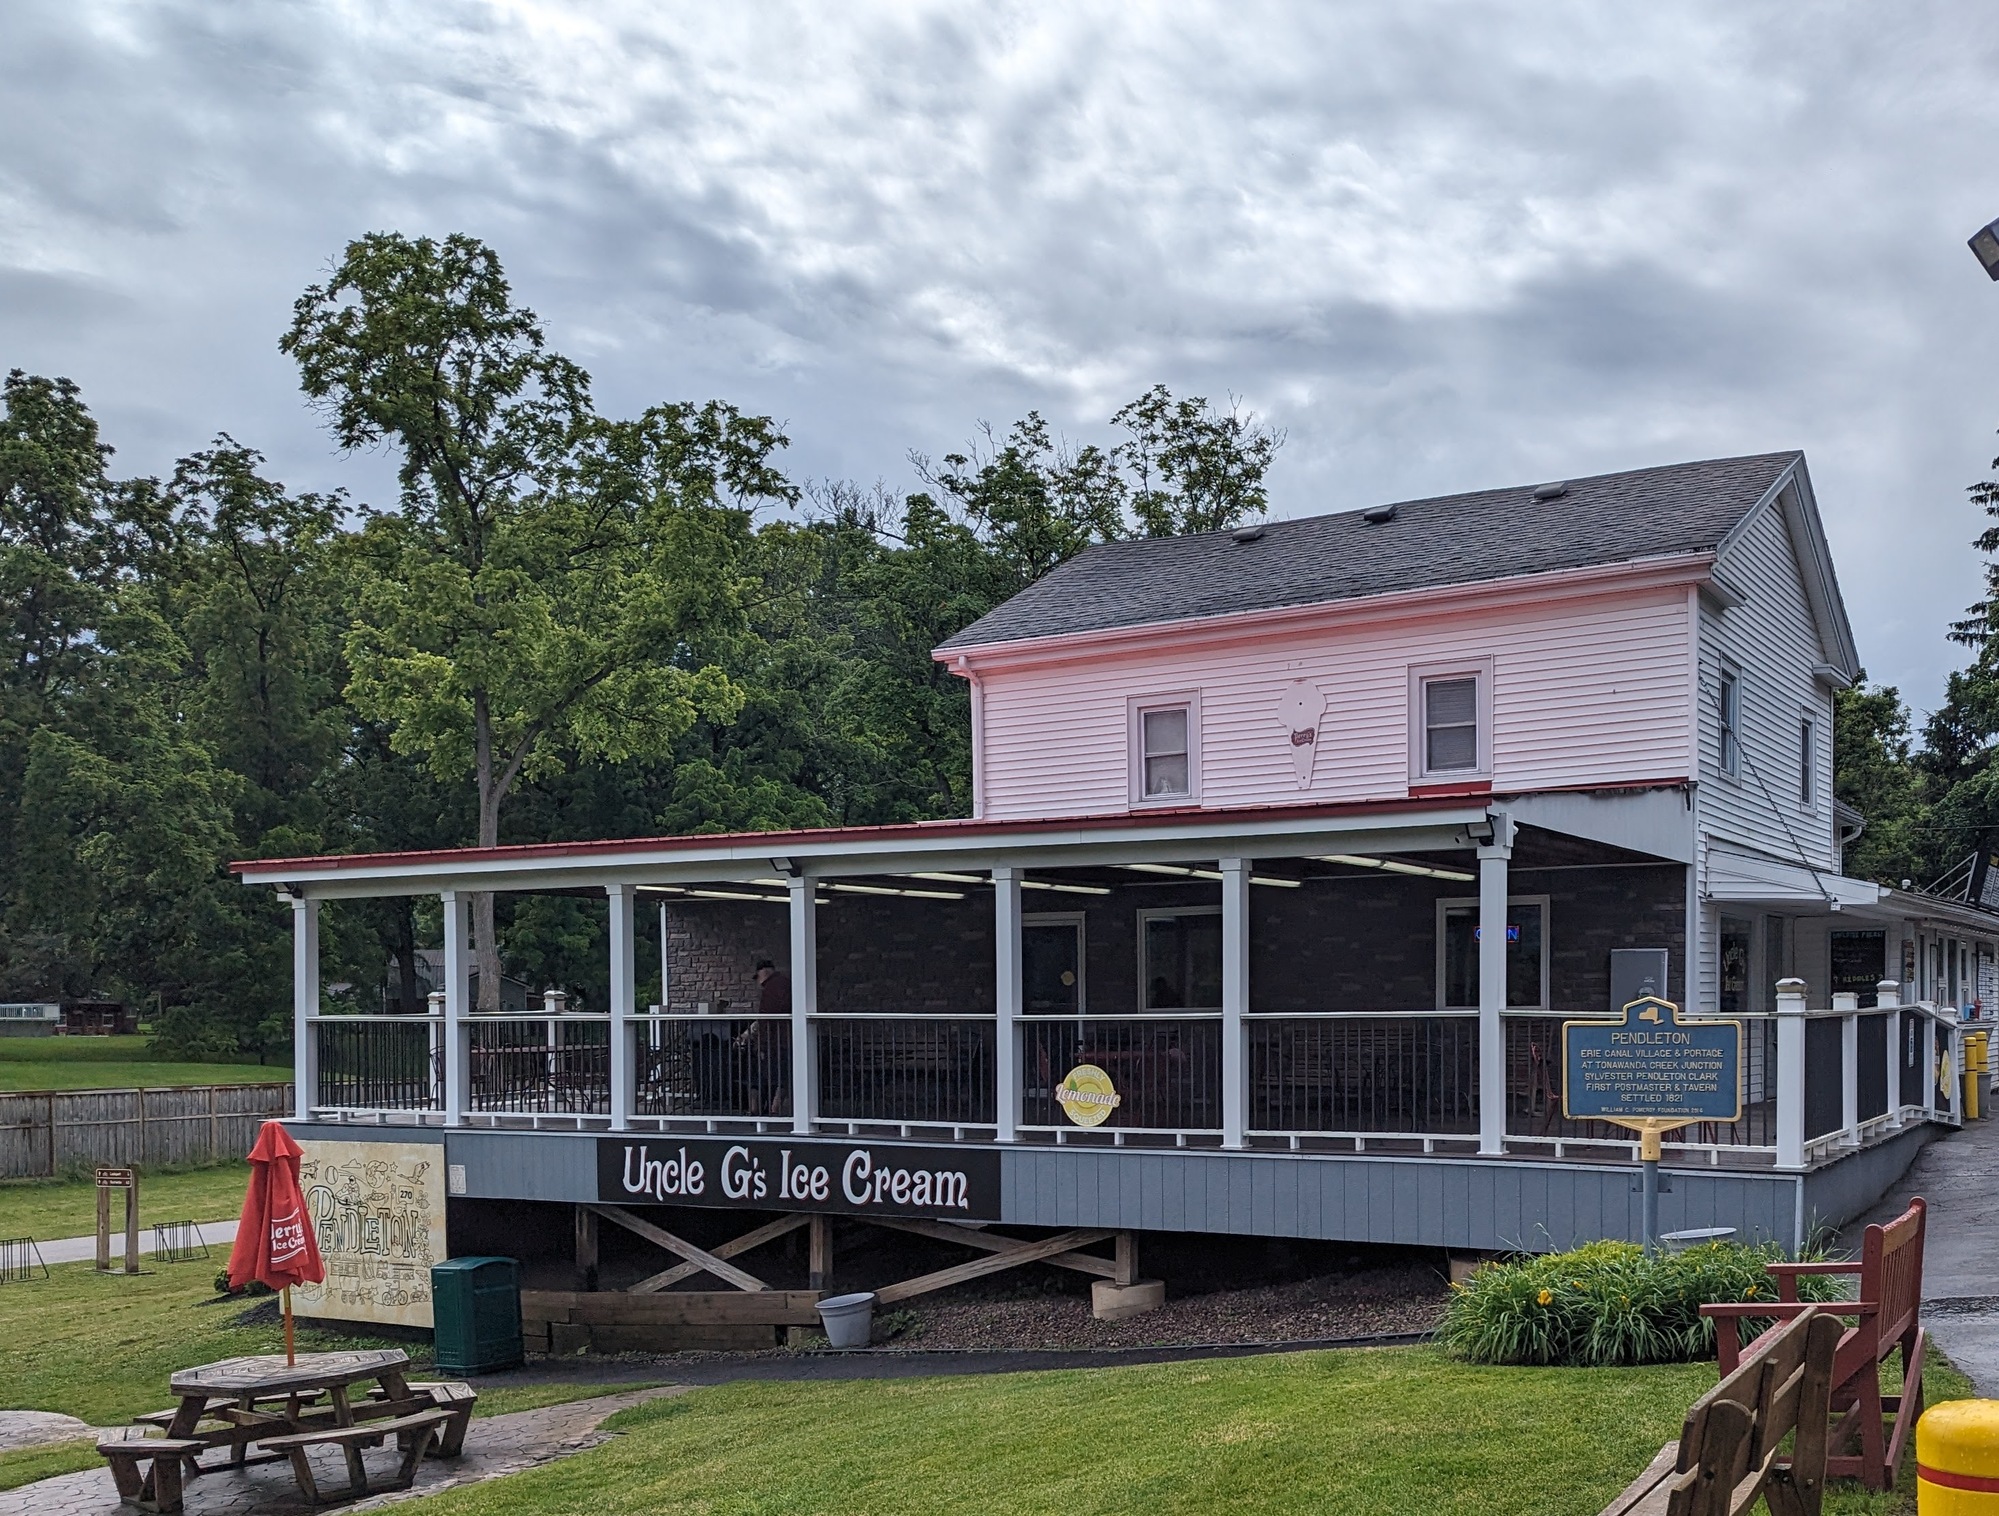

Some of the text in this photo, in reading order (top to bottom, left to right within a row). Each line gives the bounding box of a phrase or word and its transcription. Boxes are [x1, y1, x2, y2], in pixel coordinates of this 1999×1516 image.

[1611, 1032, 1690, 1045] PENDLETON
[1581, 1049, 1723, 1058] ERIE CANAL VILLAGE & PORTAGE
[1581, 1061, 1723, 1070] AT TONAWANDA CREEK JUNCTION
[1584, 1072, 1718, 1081] SYLVESTER PENDLETON CLARK
[1586, 1083, 1717, 1092] FIRST POSTMASTER & TAVERN
[1056, 1084, 1121, 1107] Lemonade
[1621, 1094, 1683, 1102] SETTLED 1821
[622, 1145, 969, 1209] Uncle G's Ice Cream
[400, 1189, 413, 1200] 270
[307, 1185, 418, 1259] PENDLETON
[272, 1239, 288, 1251] Ice
